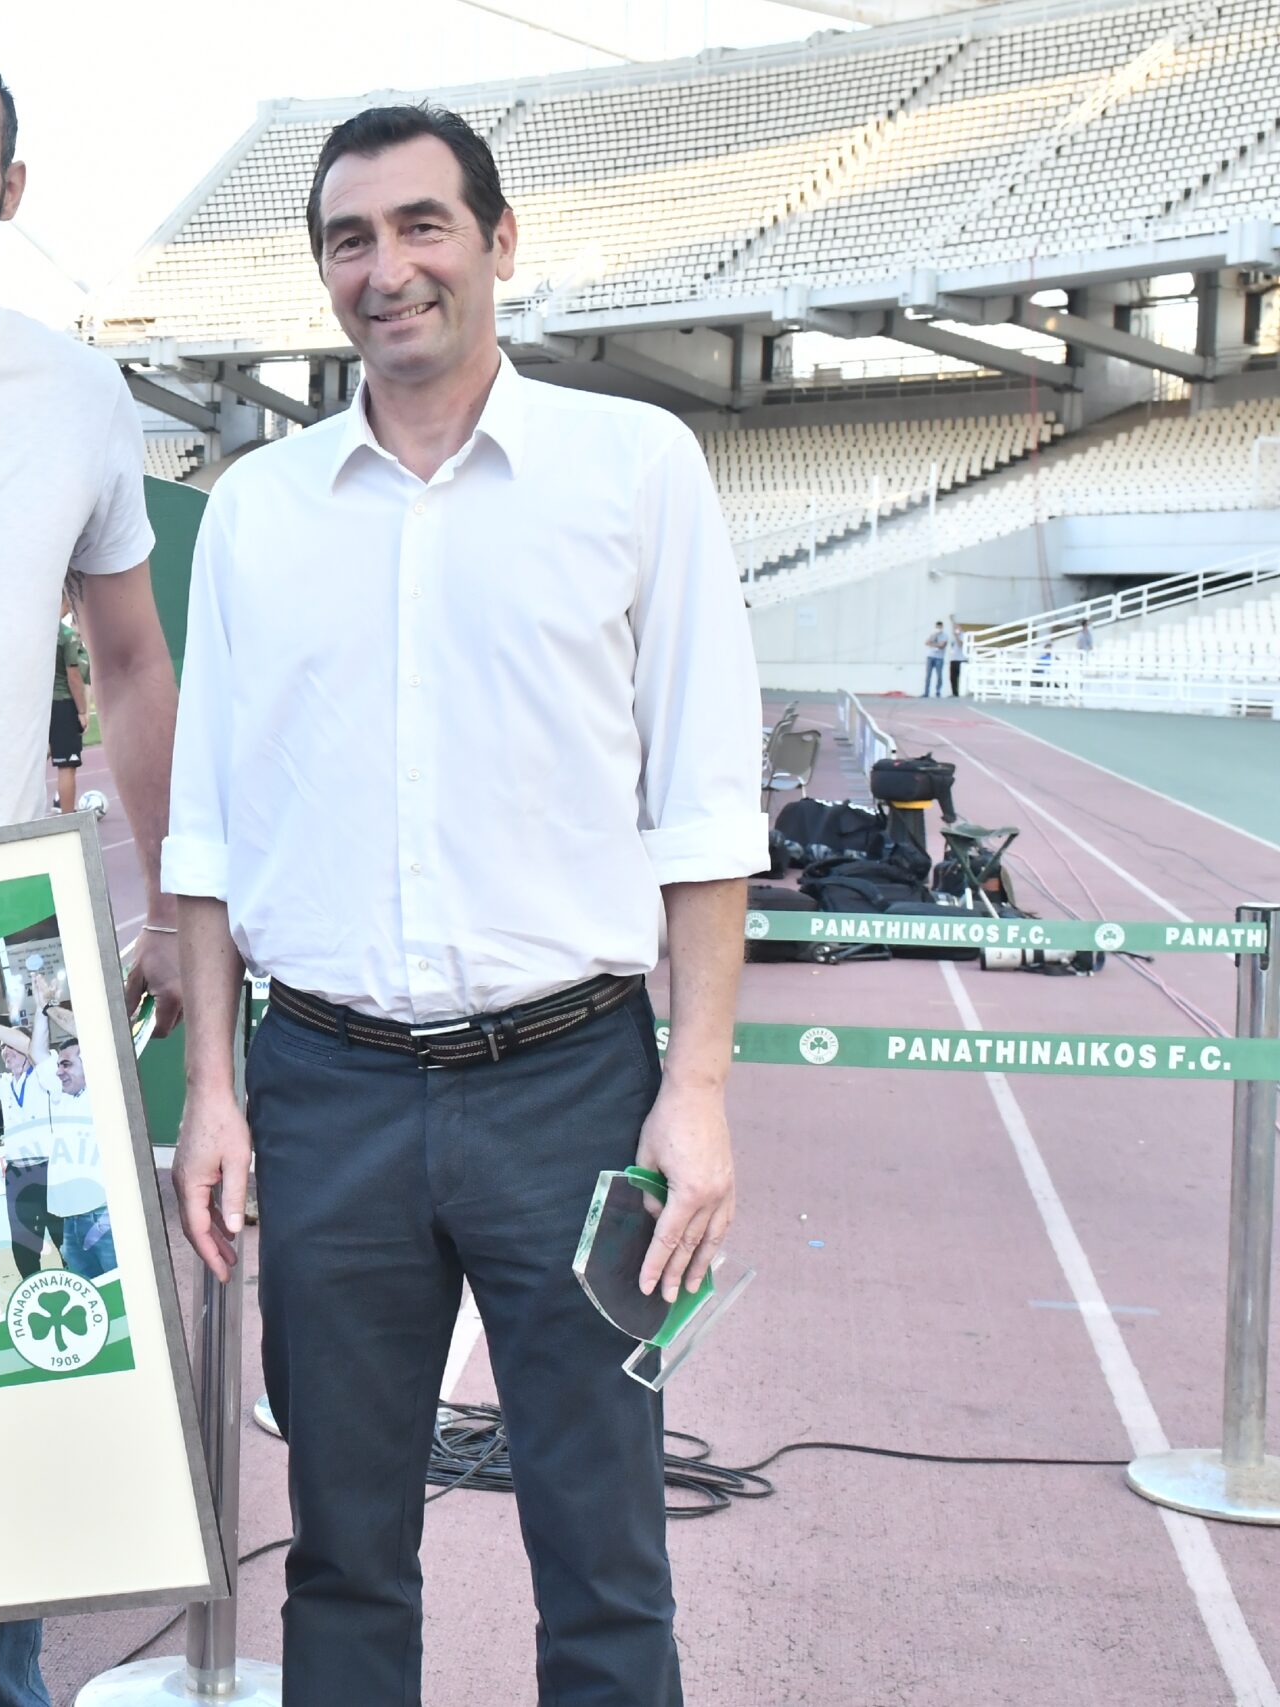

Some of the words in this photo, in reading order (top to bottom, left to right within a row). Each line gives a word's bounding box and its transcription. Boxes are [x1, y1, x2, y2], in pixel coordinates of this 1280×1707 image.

[810, 917, 999, 944] PANATHINAIKOS
[1006, 922, 1052, 945] F.C.
[887, 1036, 1157, 1069] PANATHINAIKOS
[1169, 1045, 1232, 1070] F.C.
[12, 1273, 91, 1338] ΠΑΝΑΘΗΝΑΪΚΟΣ
[50, 1353, 81, 1367] 1908
